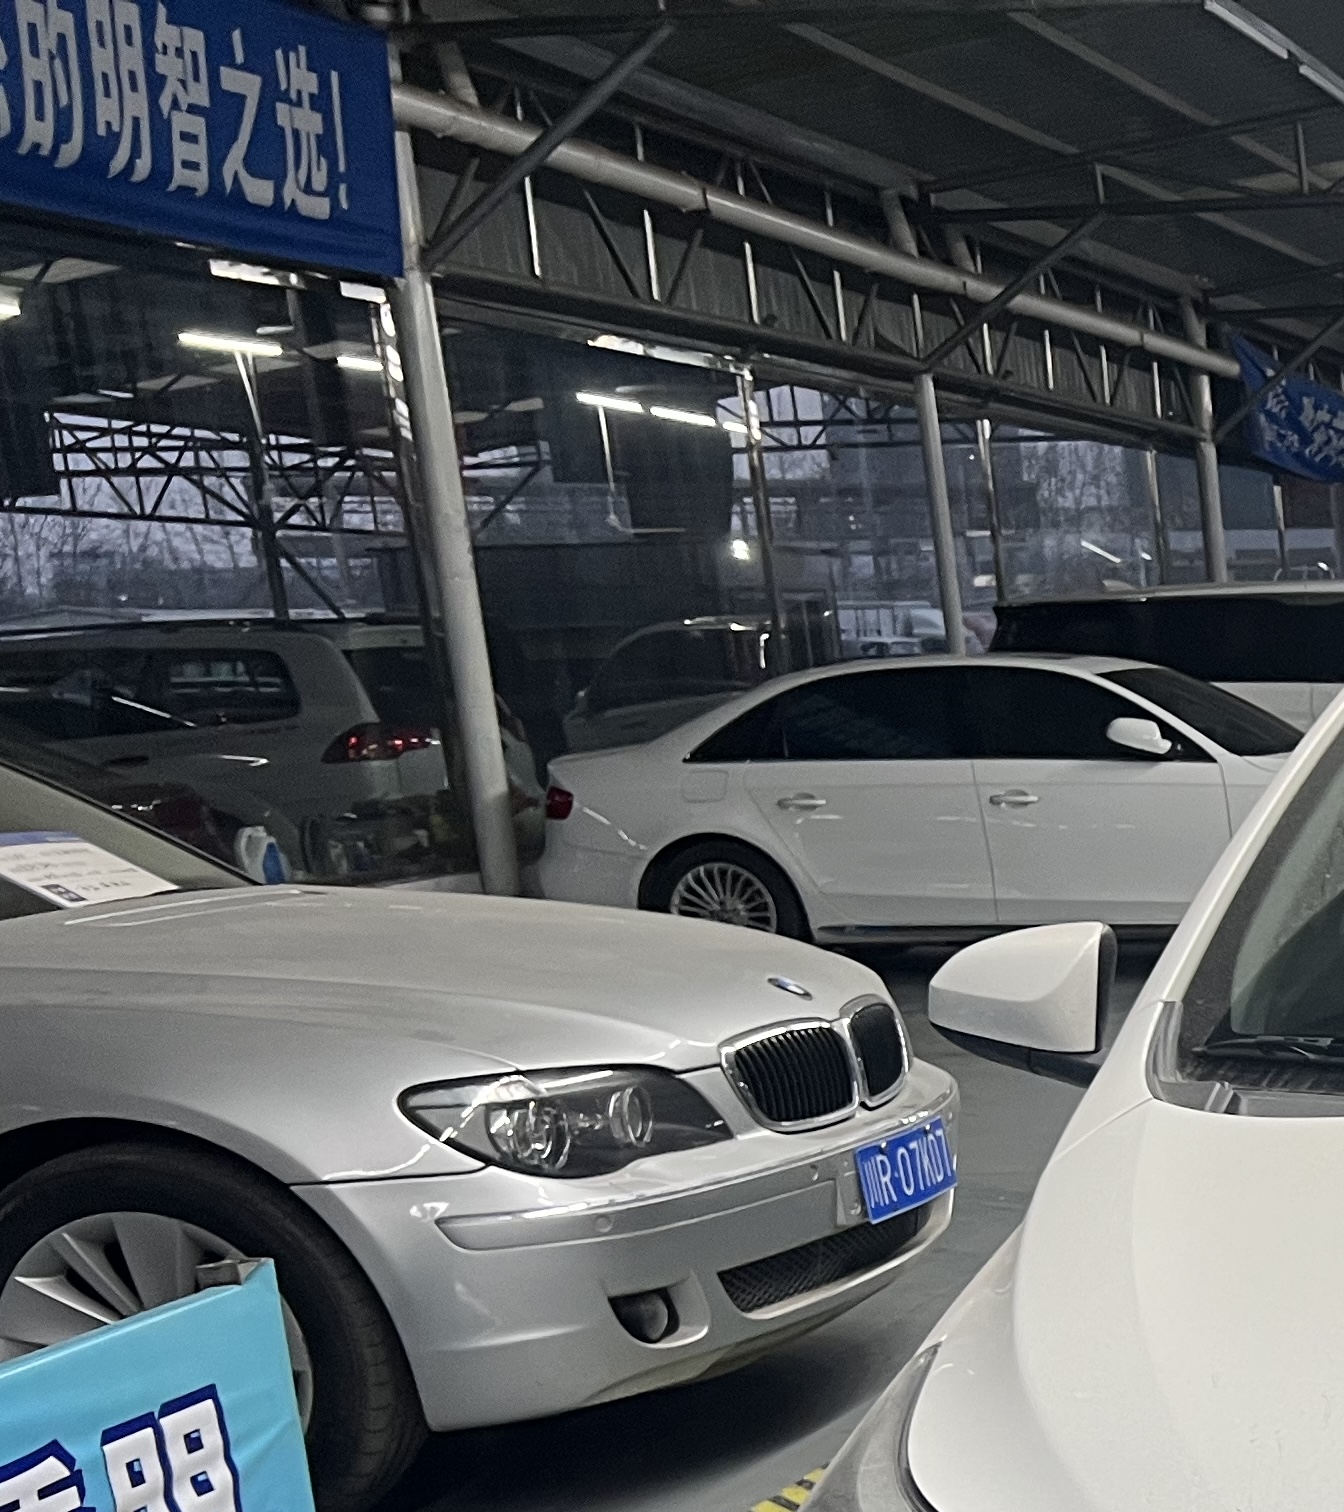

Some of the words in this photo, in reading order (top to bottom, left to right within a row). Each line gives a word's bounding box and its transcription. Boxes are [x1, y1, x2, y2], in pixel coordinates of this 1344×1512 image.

[0, 0, 349, 220] 的明智之选!
